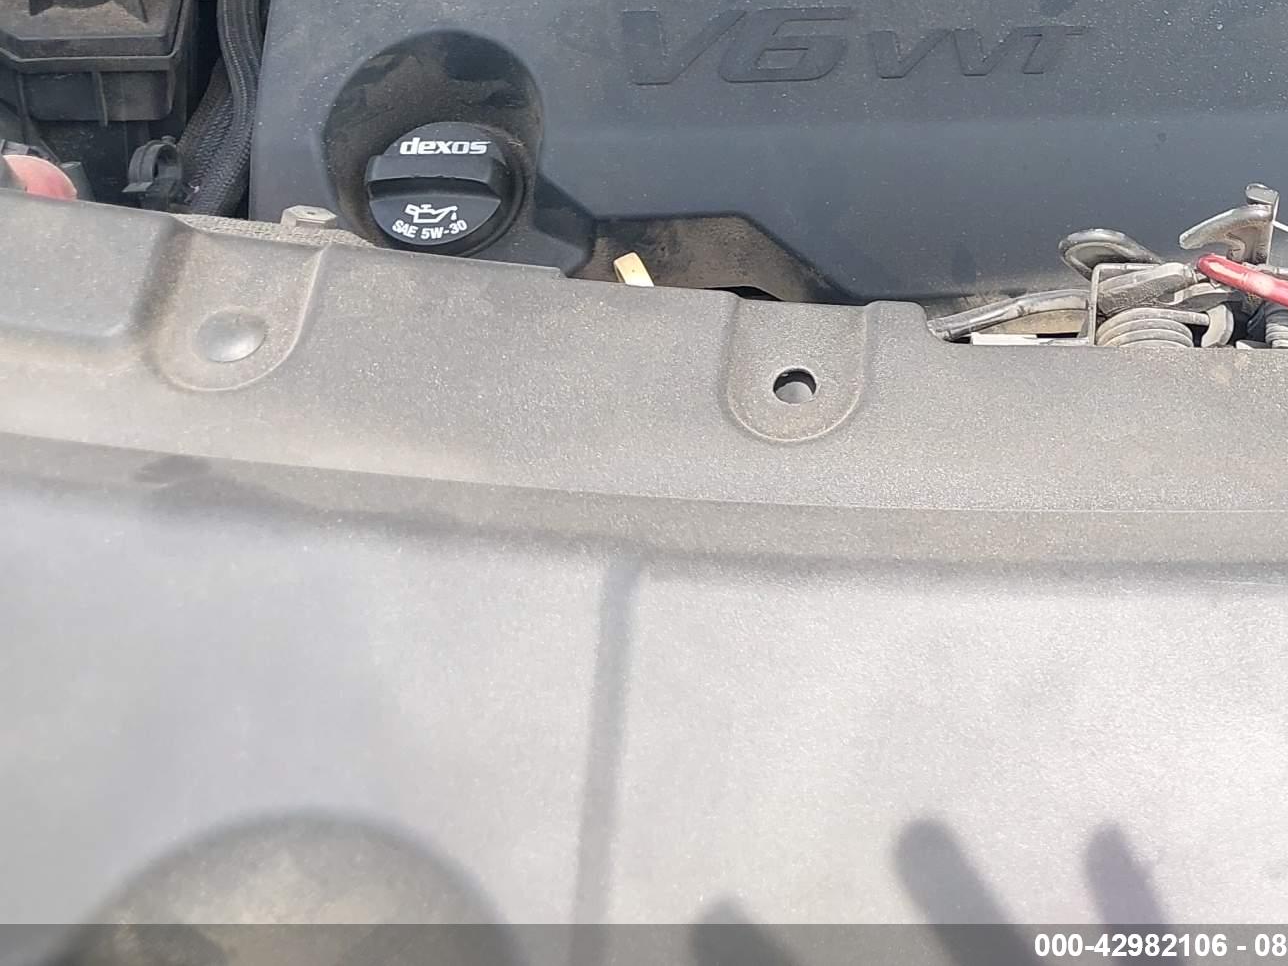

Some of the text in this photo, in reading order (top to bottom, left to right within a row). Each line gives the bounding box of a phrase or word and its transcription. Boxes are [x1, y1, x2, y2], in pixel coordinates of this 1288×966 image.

[620, 7, 854, 86] V6
[400, 137, 492, 155] dexos
[391, 219, 467, 240] SAE 5W-30
